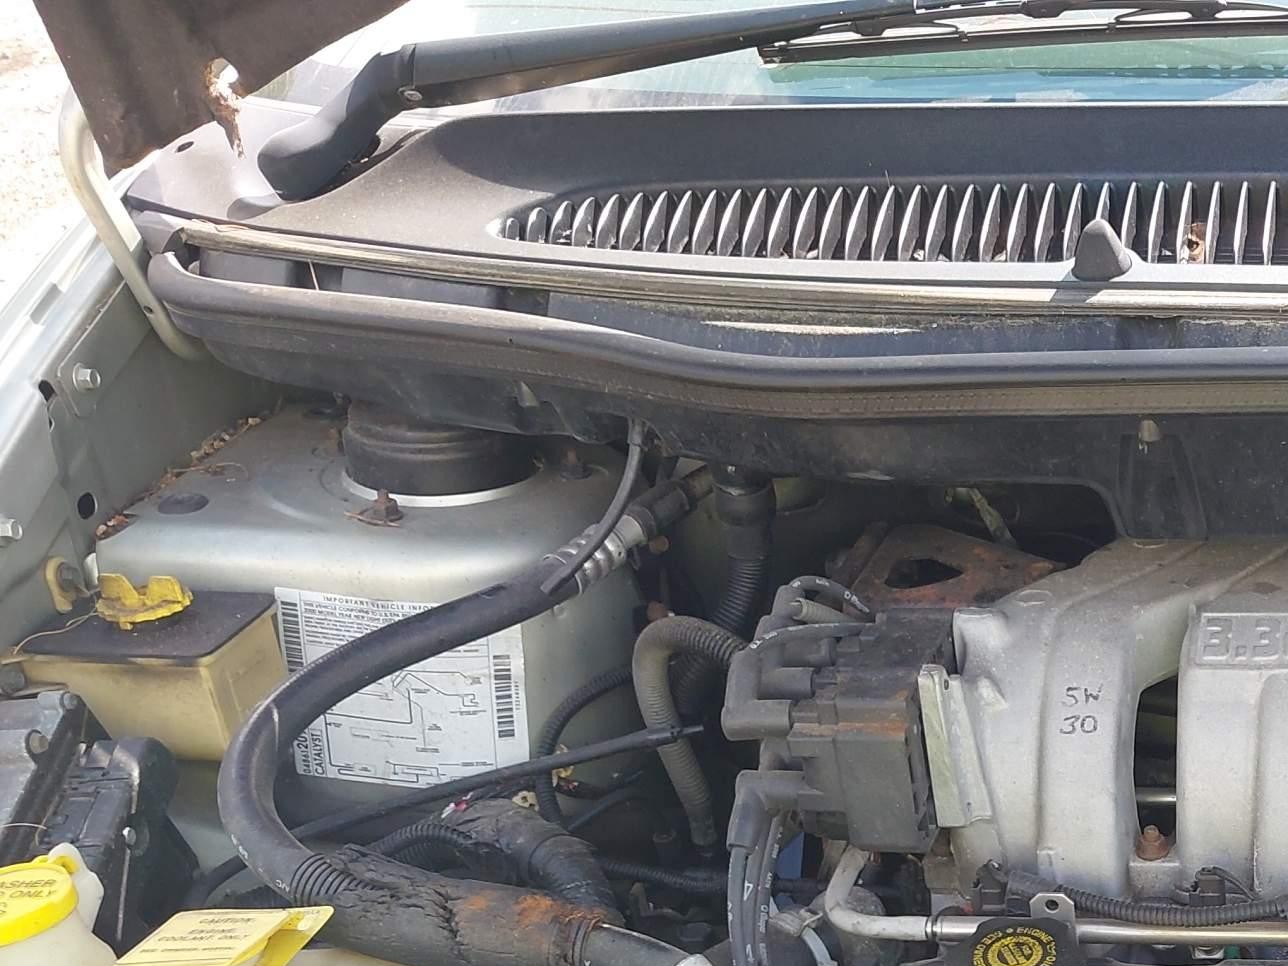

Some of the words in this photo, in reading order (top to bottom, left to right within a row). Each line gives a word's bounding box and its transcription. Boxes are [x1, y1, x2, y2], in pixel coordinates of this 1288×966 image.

[323, 596, 369, 606] IMPORTANT
[1060, 683, 1104, 707] 5W
[1059, 714, 1098, 735] 30
[311, 732, 325, 775] CATALYST
[9, 890, 58, 899] ONLY
[1016, 926, 1054, 944] ENGINE
